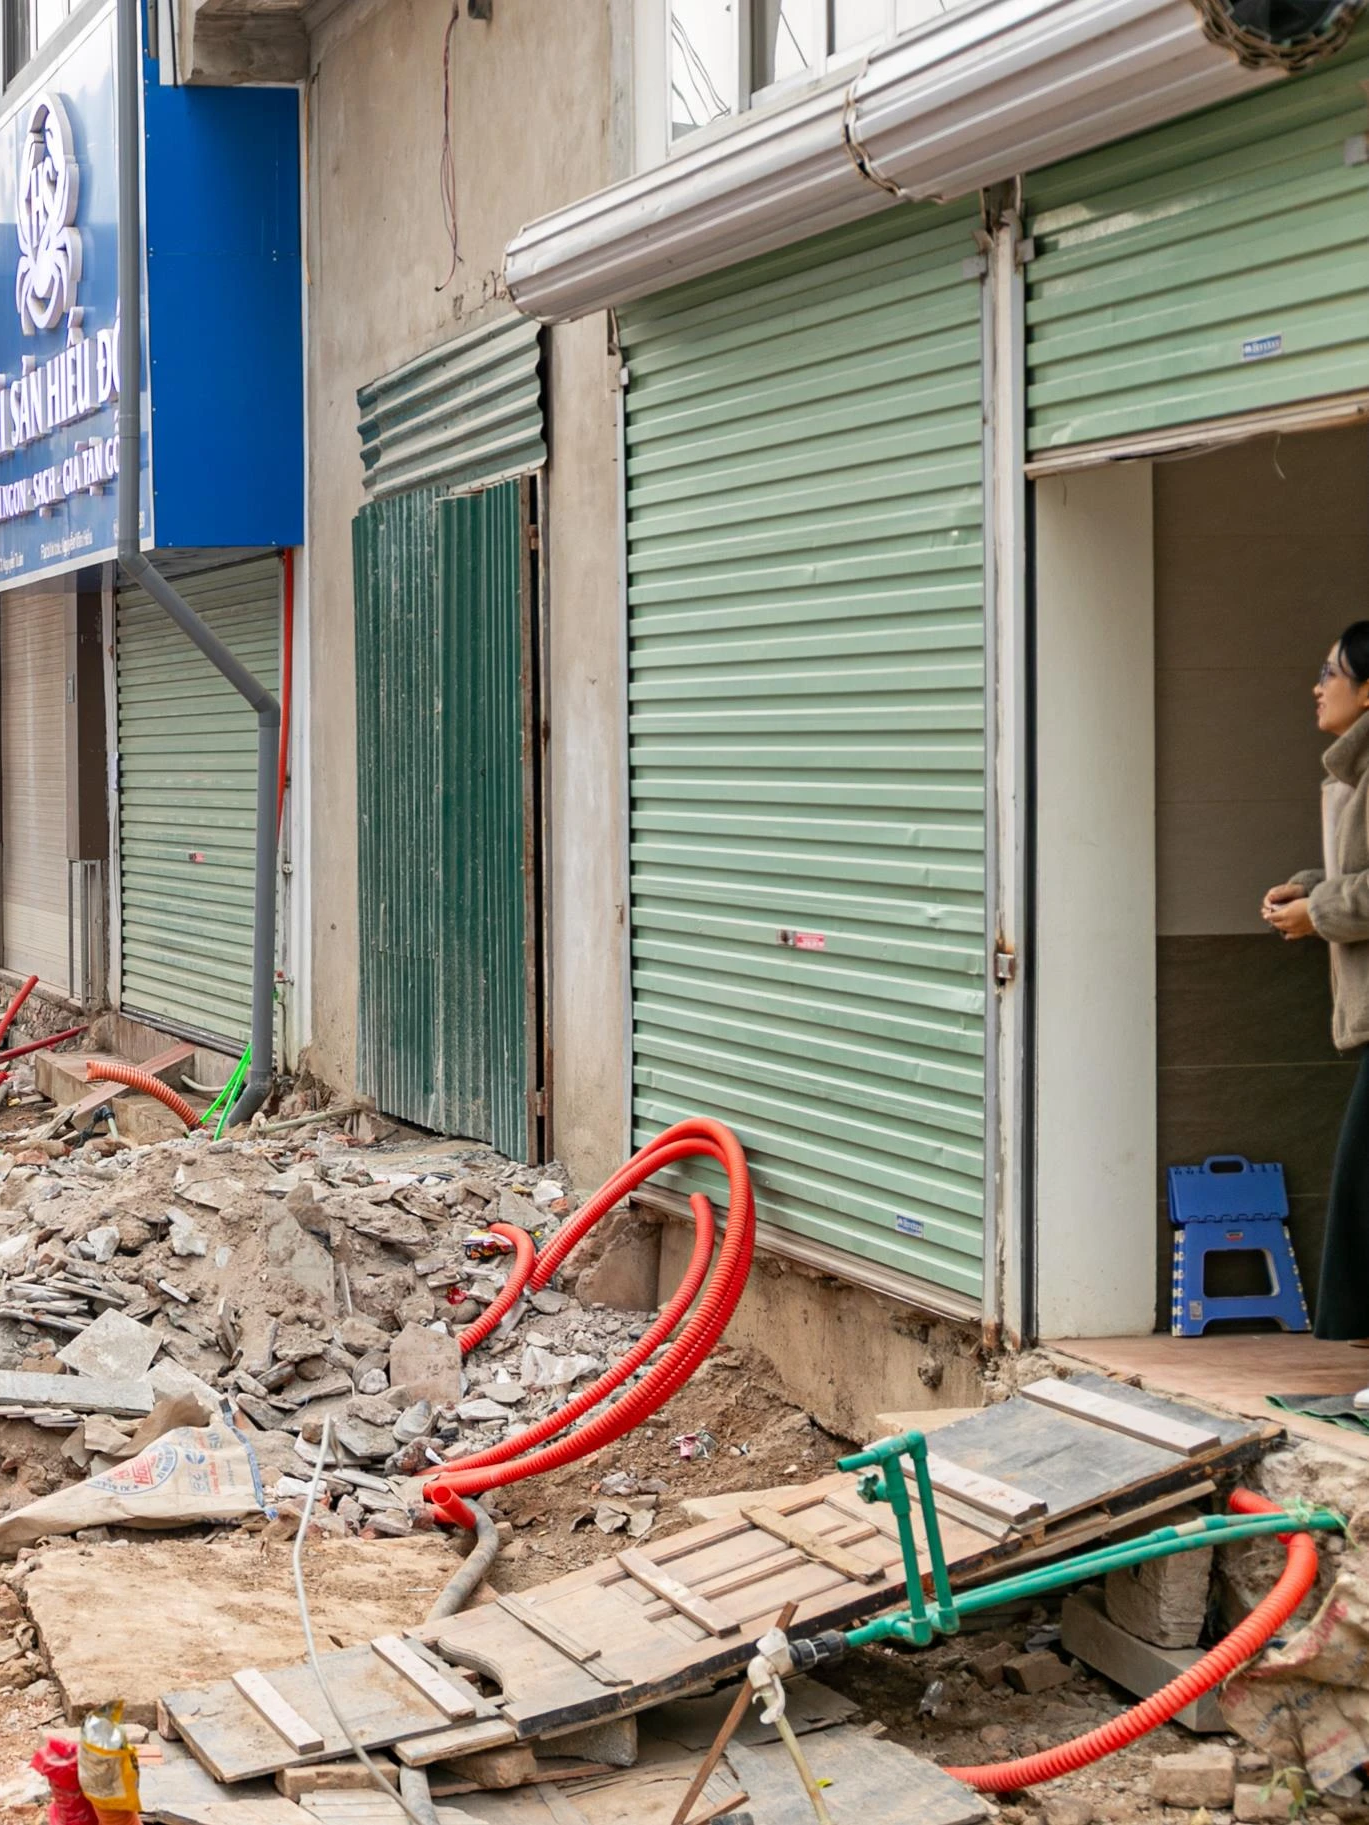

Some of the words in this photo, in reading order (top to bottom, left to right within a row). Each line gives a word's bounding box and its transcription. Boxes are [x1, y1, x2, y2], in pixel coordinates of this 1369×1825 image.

[10, 355, 44, 446] SẢN
[32, 466, 56, 517] SẠCH
[62, 441, 81, 495] GIÁ
